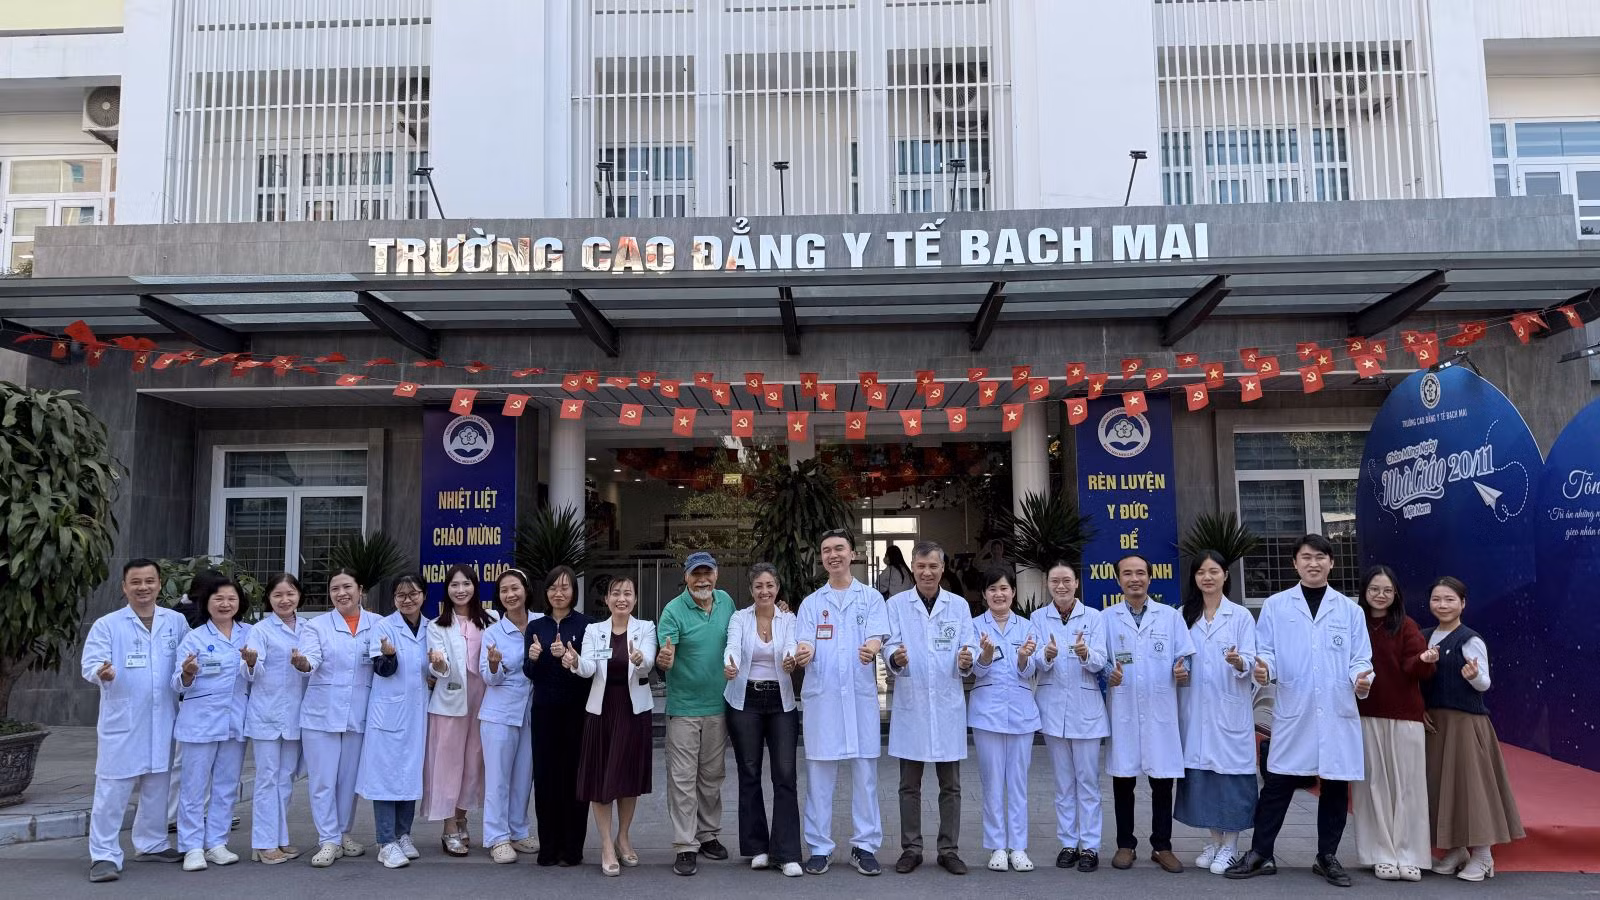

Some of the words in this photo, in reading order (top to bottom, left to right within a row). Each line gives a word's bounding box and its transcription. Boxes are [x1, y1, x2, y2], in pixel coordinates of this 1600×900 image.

[368, 227, 564, 275] TRƯỜNG
[581, 236, 675, 274] CAO
[691, 217, 826, 273] ĐẲNG
[842, 232, 871, 270] Y
[886, 218, 945, 268] TẾ
[1112, 222, 1209, 263] MAI
[1448, 444, 1494, 482] 20/11
[1088, 471, 1117, 490] RÈN
[1120, 471, 1166, 493] LUYỆN
[438, 487, 471, 513] NHIỆT
[474, 486, 498, 513] LIỆT
[1106, 504, 1116, 520] Y
[1120, 500, 1149, 520] ĐỨC
[433, 523, 464, 546] CHÀO
[467, 523, 502, 546] MỪNG
[1120, 528, 1139, 550] ĐỂ
[1089, 561, 1118, 580] XỨN
